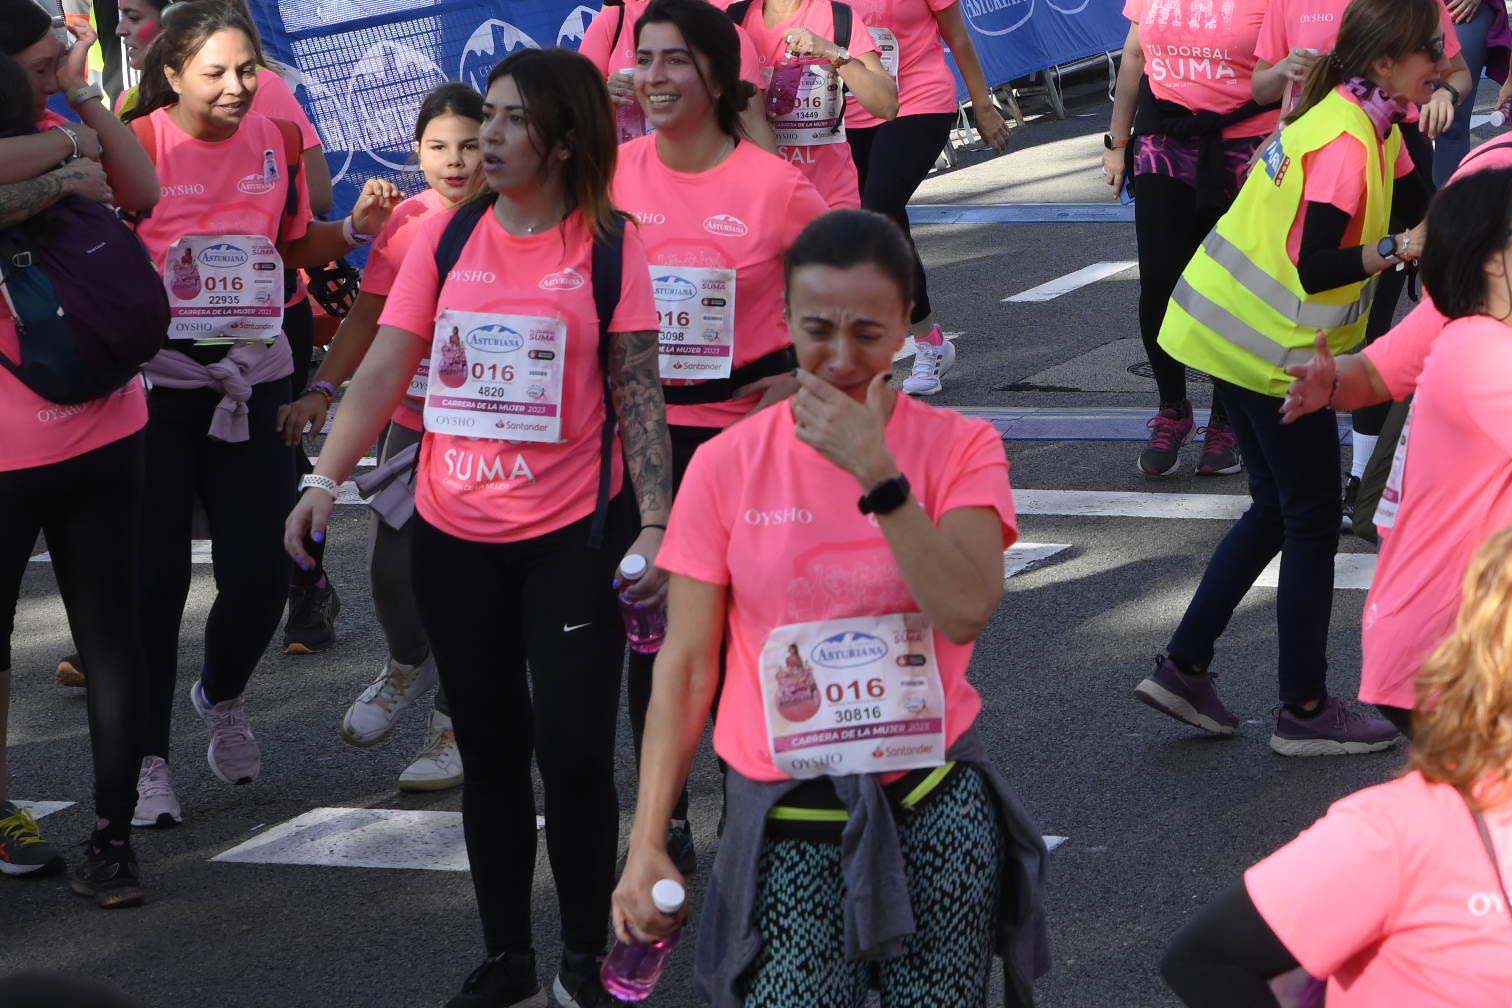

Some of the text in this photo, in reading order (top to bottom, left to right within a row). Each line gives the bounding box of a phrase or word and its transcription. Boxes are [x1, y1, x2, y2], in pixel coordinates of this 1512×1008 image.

[1299, 12, 1334, 25] OYSHO
[1167, 44, 1232, 61] DORSAL
[1151, 57, 1237, 82] SUMA
[795, 111, 819, 120] 13449
[778, 146, 816, 165] SAL
[159, 183, 205, 197] OYSHO
[634, 211, 667, 226] SHO
[200, 250, 246, 263] ASTURIANA
[204, 276, 244, 291] 016
[702, 281, 726, 290] SUMA
[208, 295, 240, 306] 22935
[175, 322, 212, 332] OYSHO
[239, 322, 275, 331] Santander
[468, 333, 522, 348] ASTURIANA
[528, 333, 556, 345] SUMA
[471, 360, 516, 384] 016
[683, 361, 722, 371] Santander
[477, 386, 505, 398] 4820
[441, 398, 476, 409] CARRERA
[476, 401, 487, 409] DE
[487, 402, 498, 410] LA
[499, 403, 525, 412] MUJER
[435, 415, 476, 429] OYSHO
[505, 420, 549, 432] Santander
[443, 448, 538, 482] SUMA
[745, 506, 813, 526] OYSHO
[818, 645, 884, 662] ASTURIANA
[825, 677, 886, 704] 016
[834, 706, 882, 724] 30816
[790, 732, 839, 747] CARRERA
[840, 730, 857, 741] DE
[857, 728, 871, 739] LA
[871, 724, 908, 738] MUJER
[884, 742, 934, 758] Santander
[790, 752, 844, 771] OYSHO
